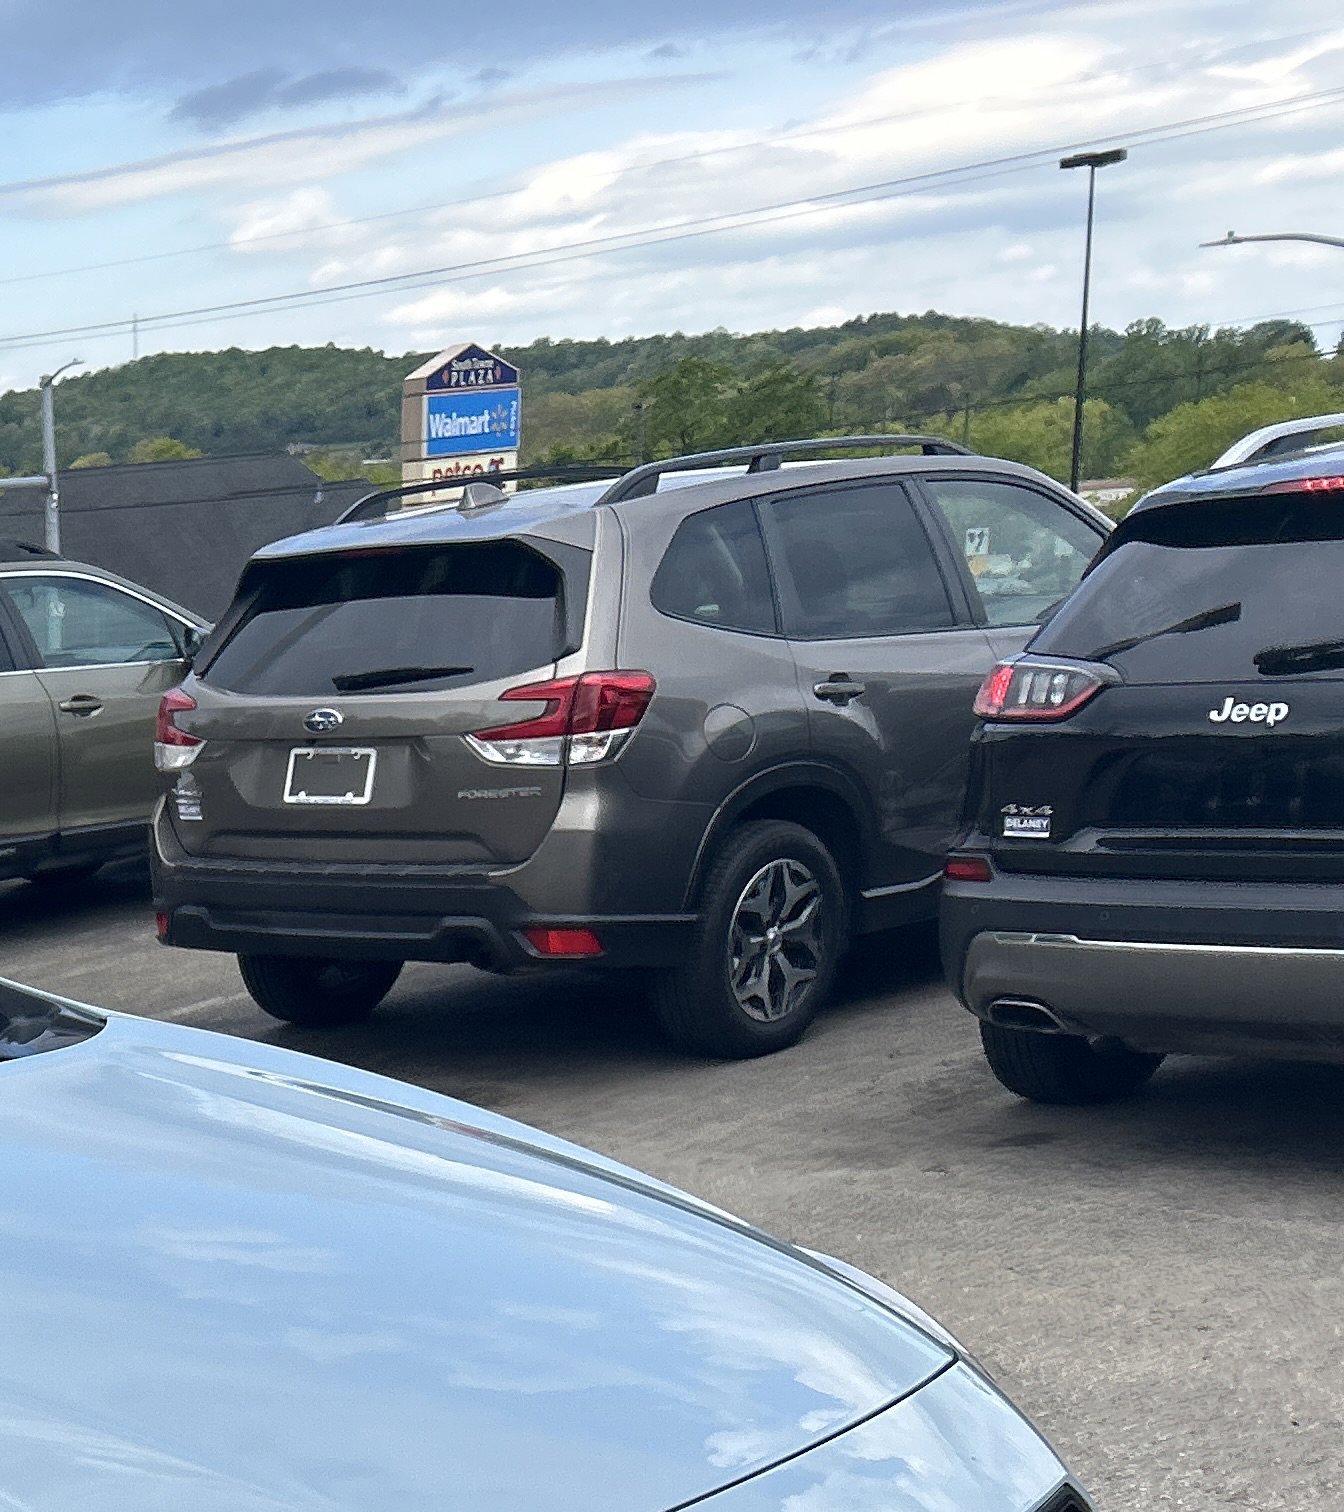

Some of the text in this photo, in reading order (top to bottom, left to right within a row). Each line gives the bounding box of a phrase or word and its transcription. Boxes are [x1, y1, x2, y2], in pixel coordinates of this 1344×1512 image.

[450, 369, 494, 387] PLAZA
[429, 409, 491, 438] Walmart
[1209, 697, 1289, 727] Jeep
[457, 786, 542, 799] FORESTER
[1006, 818, 1049, 829] DELANEY
